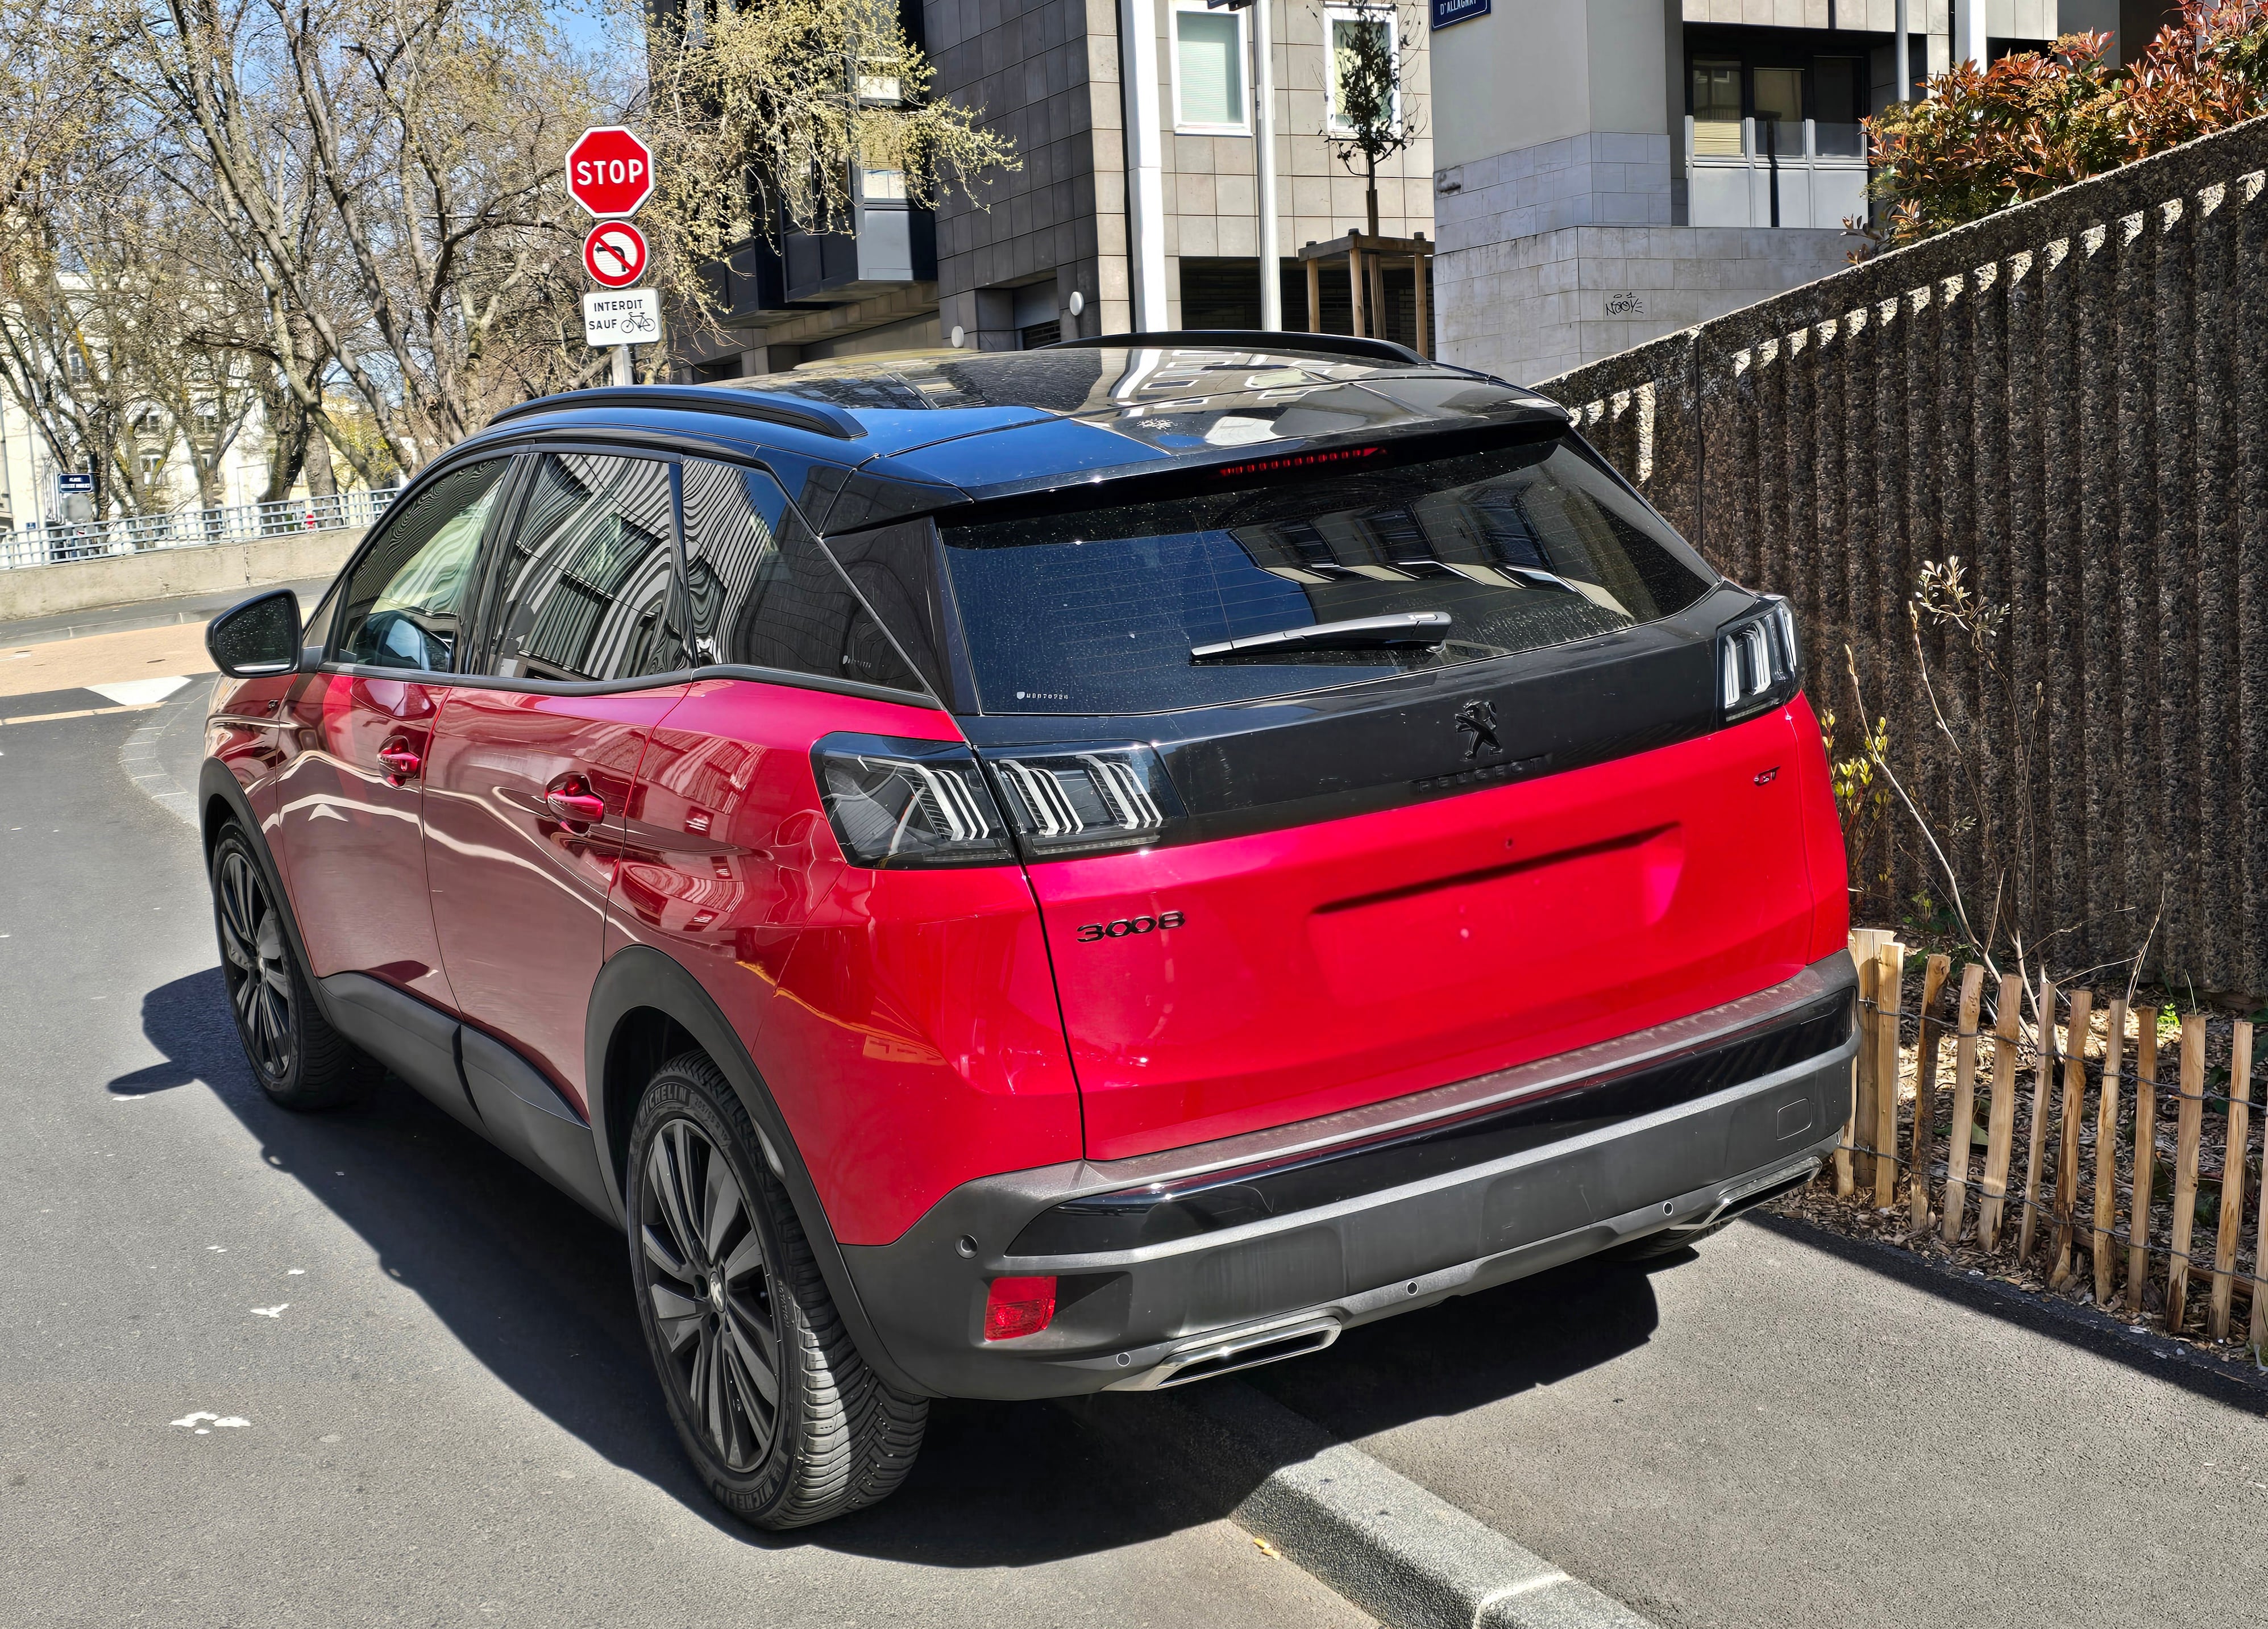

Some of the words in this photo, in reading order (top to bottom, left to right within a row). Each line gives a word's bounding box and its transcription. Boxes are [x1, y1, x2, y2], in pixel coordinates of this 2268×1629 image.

[576, 159, 643, 186] STOP
[594, 299, 643, 312] INTERDIT
[589, 319, 617, 330] SAUF
[1418, 758, 1542, 793] PEUGEOT
[1077, 911, 1186, 943] 3008
[639, 1084, 687, 1125] MICHELIN
[715, 1478, 774, 1509] MICHELIN
